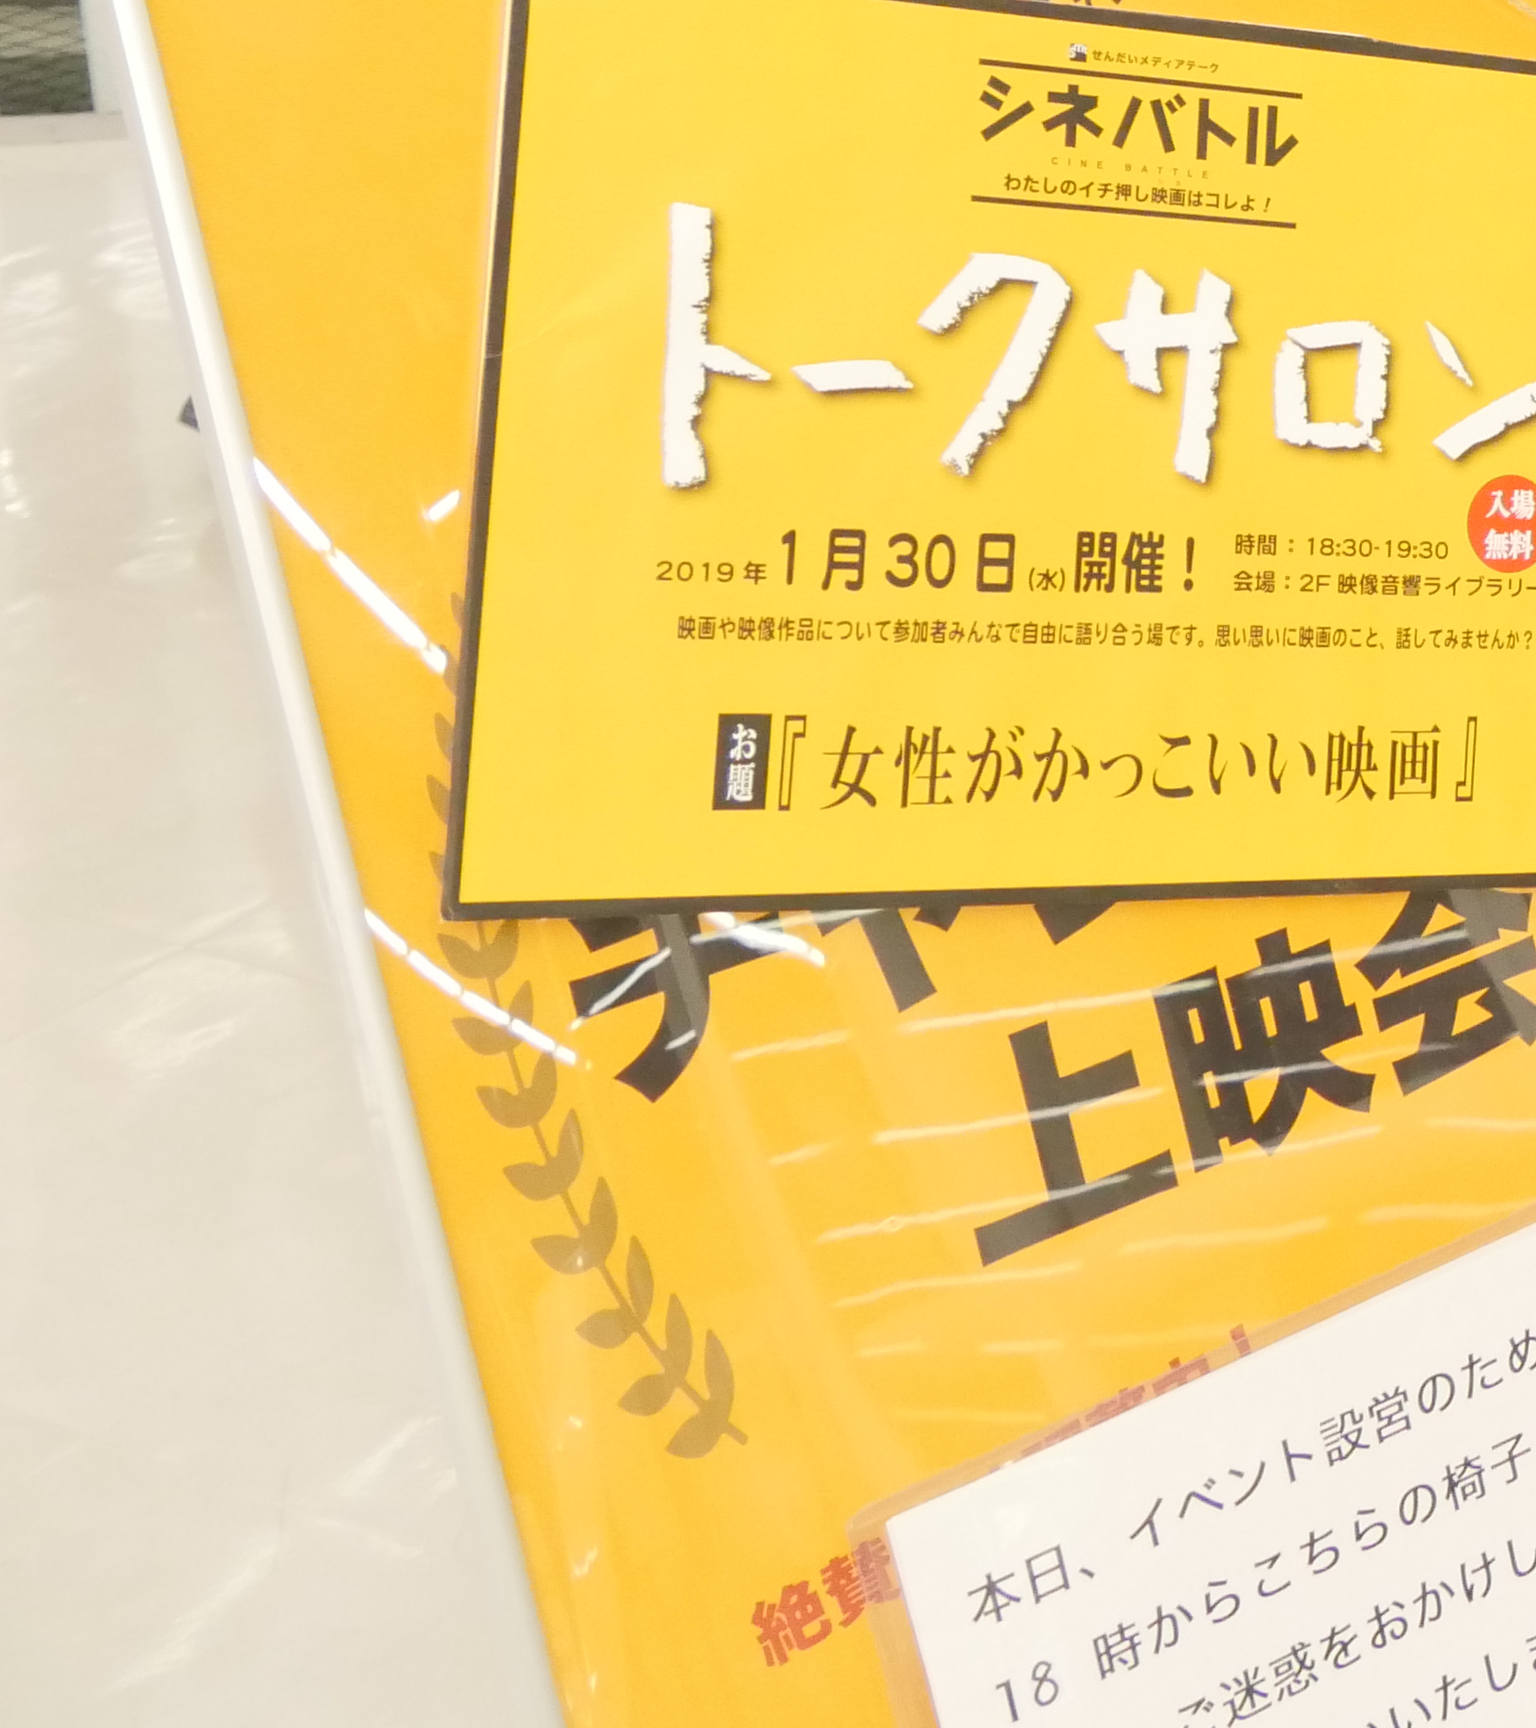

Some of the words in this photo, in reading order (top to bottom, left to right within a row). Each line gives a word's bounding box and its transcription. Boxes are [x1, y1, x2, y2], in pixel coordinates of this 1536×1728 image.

[1092, 49, 1220, 74] せんだいメディアテーク
[978, 74, 1300, 168] シネバトル
[1051, 156, 1105, 170] CINE
[1124, 162, 1209, 180] BATTLE
[1003, 173, 1272, 214] わたしのイチ押し映画はコレよ！
[1484, 489, 1536, 520] 入場
[1483, 528, 1535, 561] 無料
[724, 722, 759, 803] お題
[777, 713, 1479, 811] 『女性がかっこいい映画』
